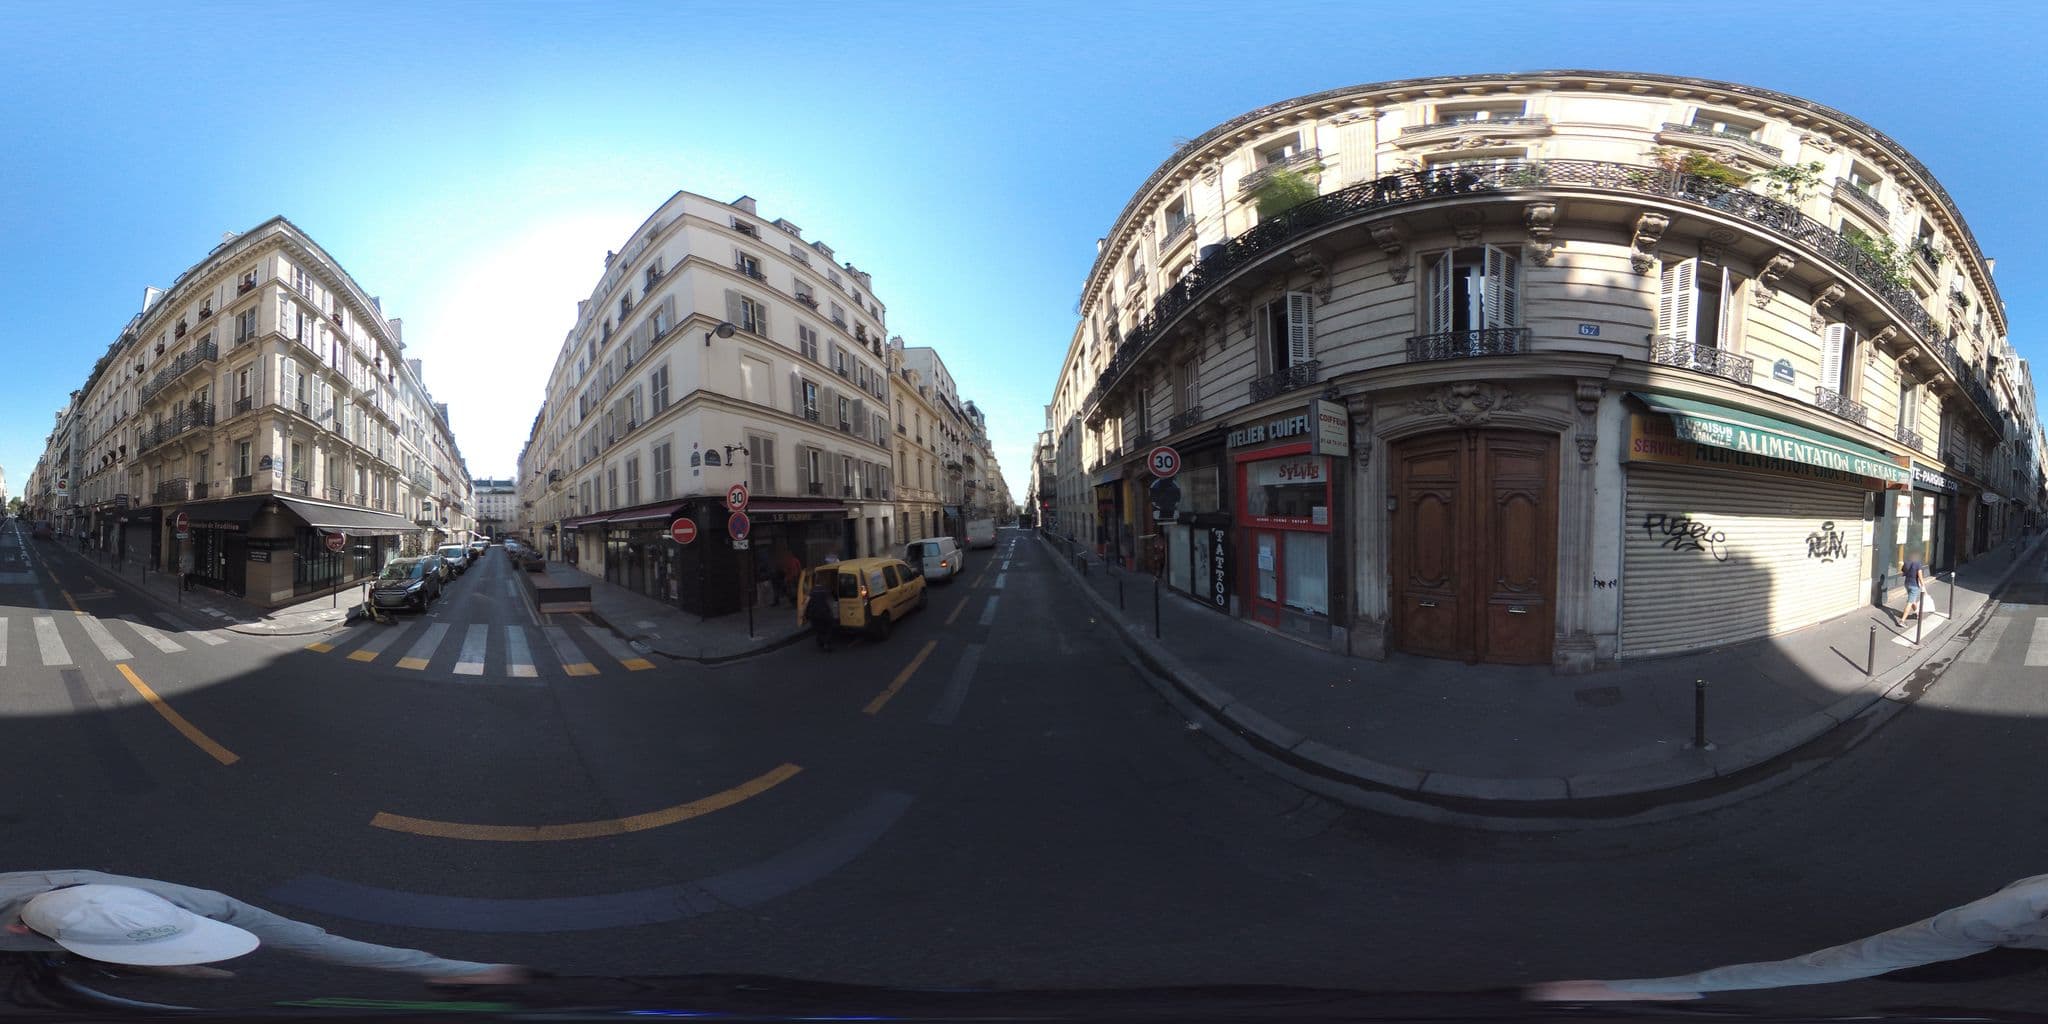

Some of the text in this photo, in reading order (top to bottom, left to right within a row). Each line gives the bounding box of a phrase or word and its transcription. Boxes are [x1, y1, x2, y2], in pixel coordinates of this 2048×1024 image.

[1581, 325, 1598, 335] 67
[1227, 425, 1265, 448] ATELIER
[1634, 438, 1684, 457] SERVICE
[1737, 430, 1849, 471] ALIMENTATION
[1155, 455, 1174, 469] 30
[731, 492, 743, 504] 30
[1214, 529, 1225, 606] TATTOO
